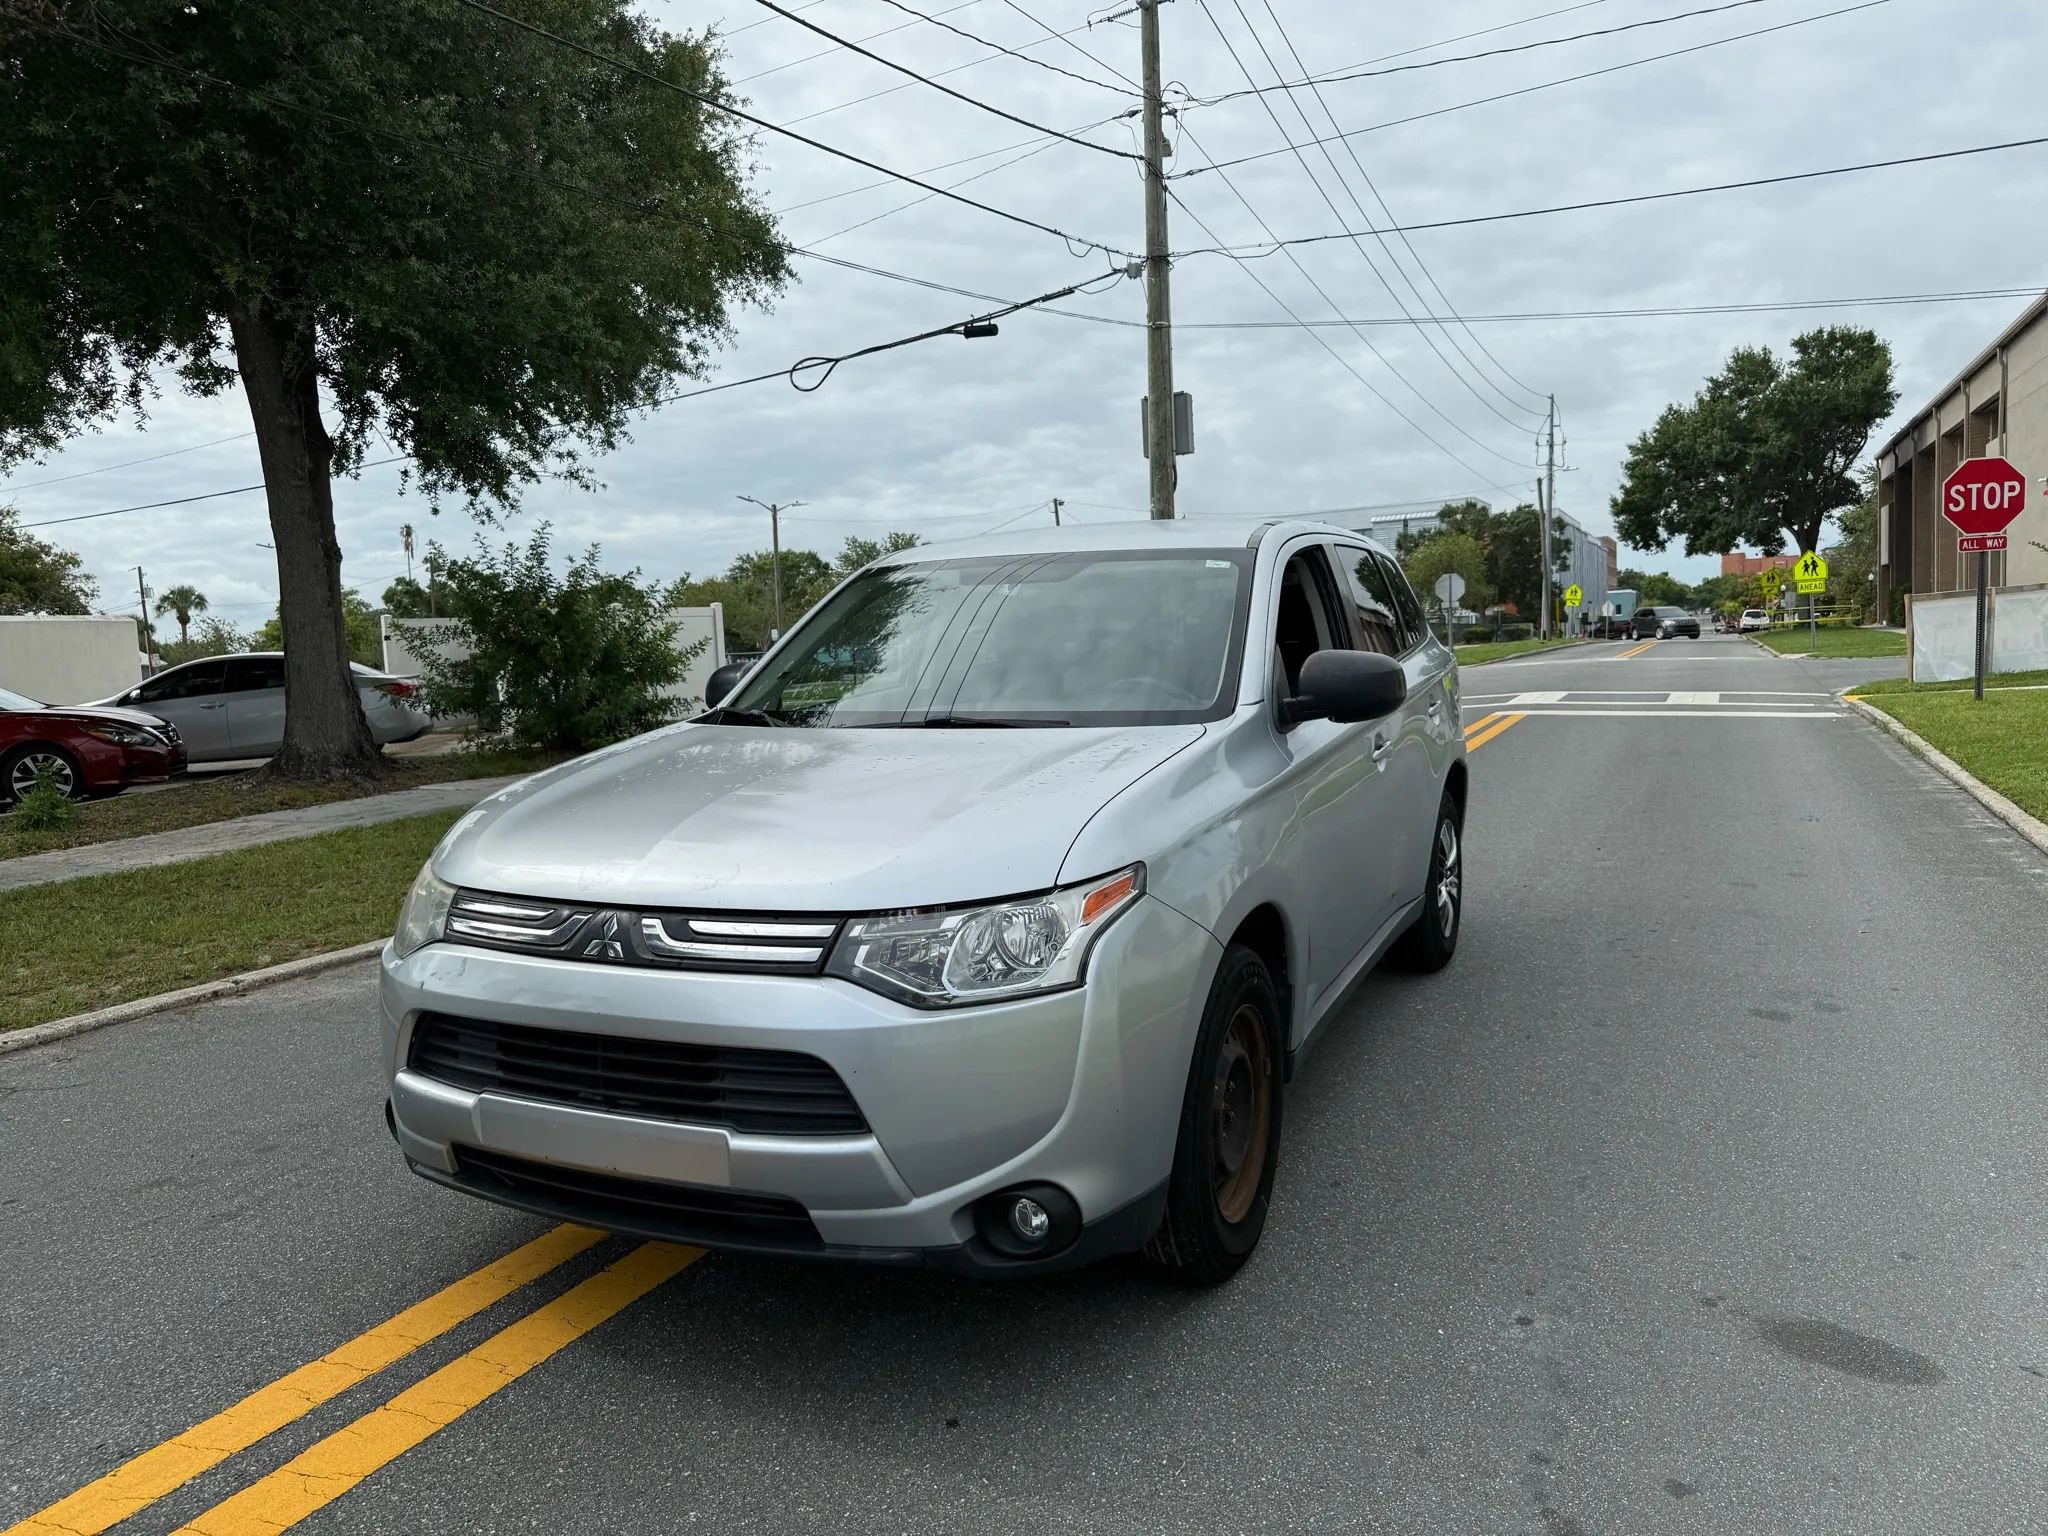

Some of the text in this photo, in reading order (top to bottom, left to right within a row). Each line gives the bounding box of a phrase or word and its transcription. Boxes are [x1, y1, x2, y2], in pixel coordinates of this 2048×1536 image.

[1948, 480, 2021, 512] STOP
[1962, 538, 2004, 550] ALL WAY
[1799, 582, 1823, 591] AHEAD
